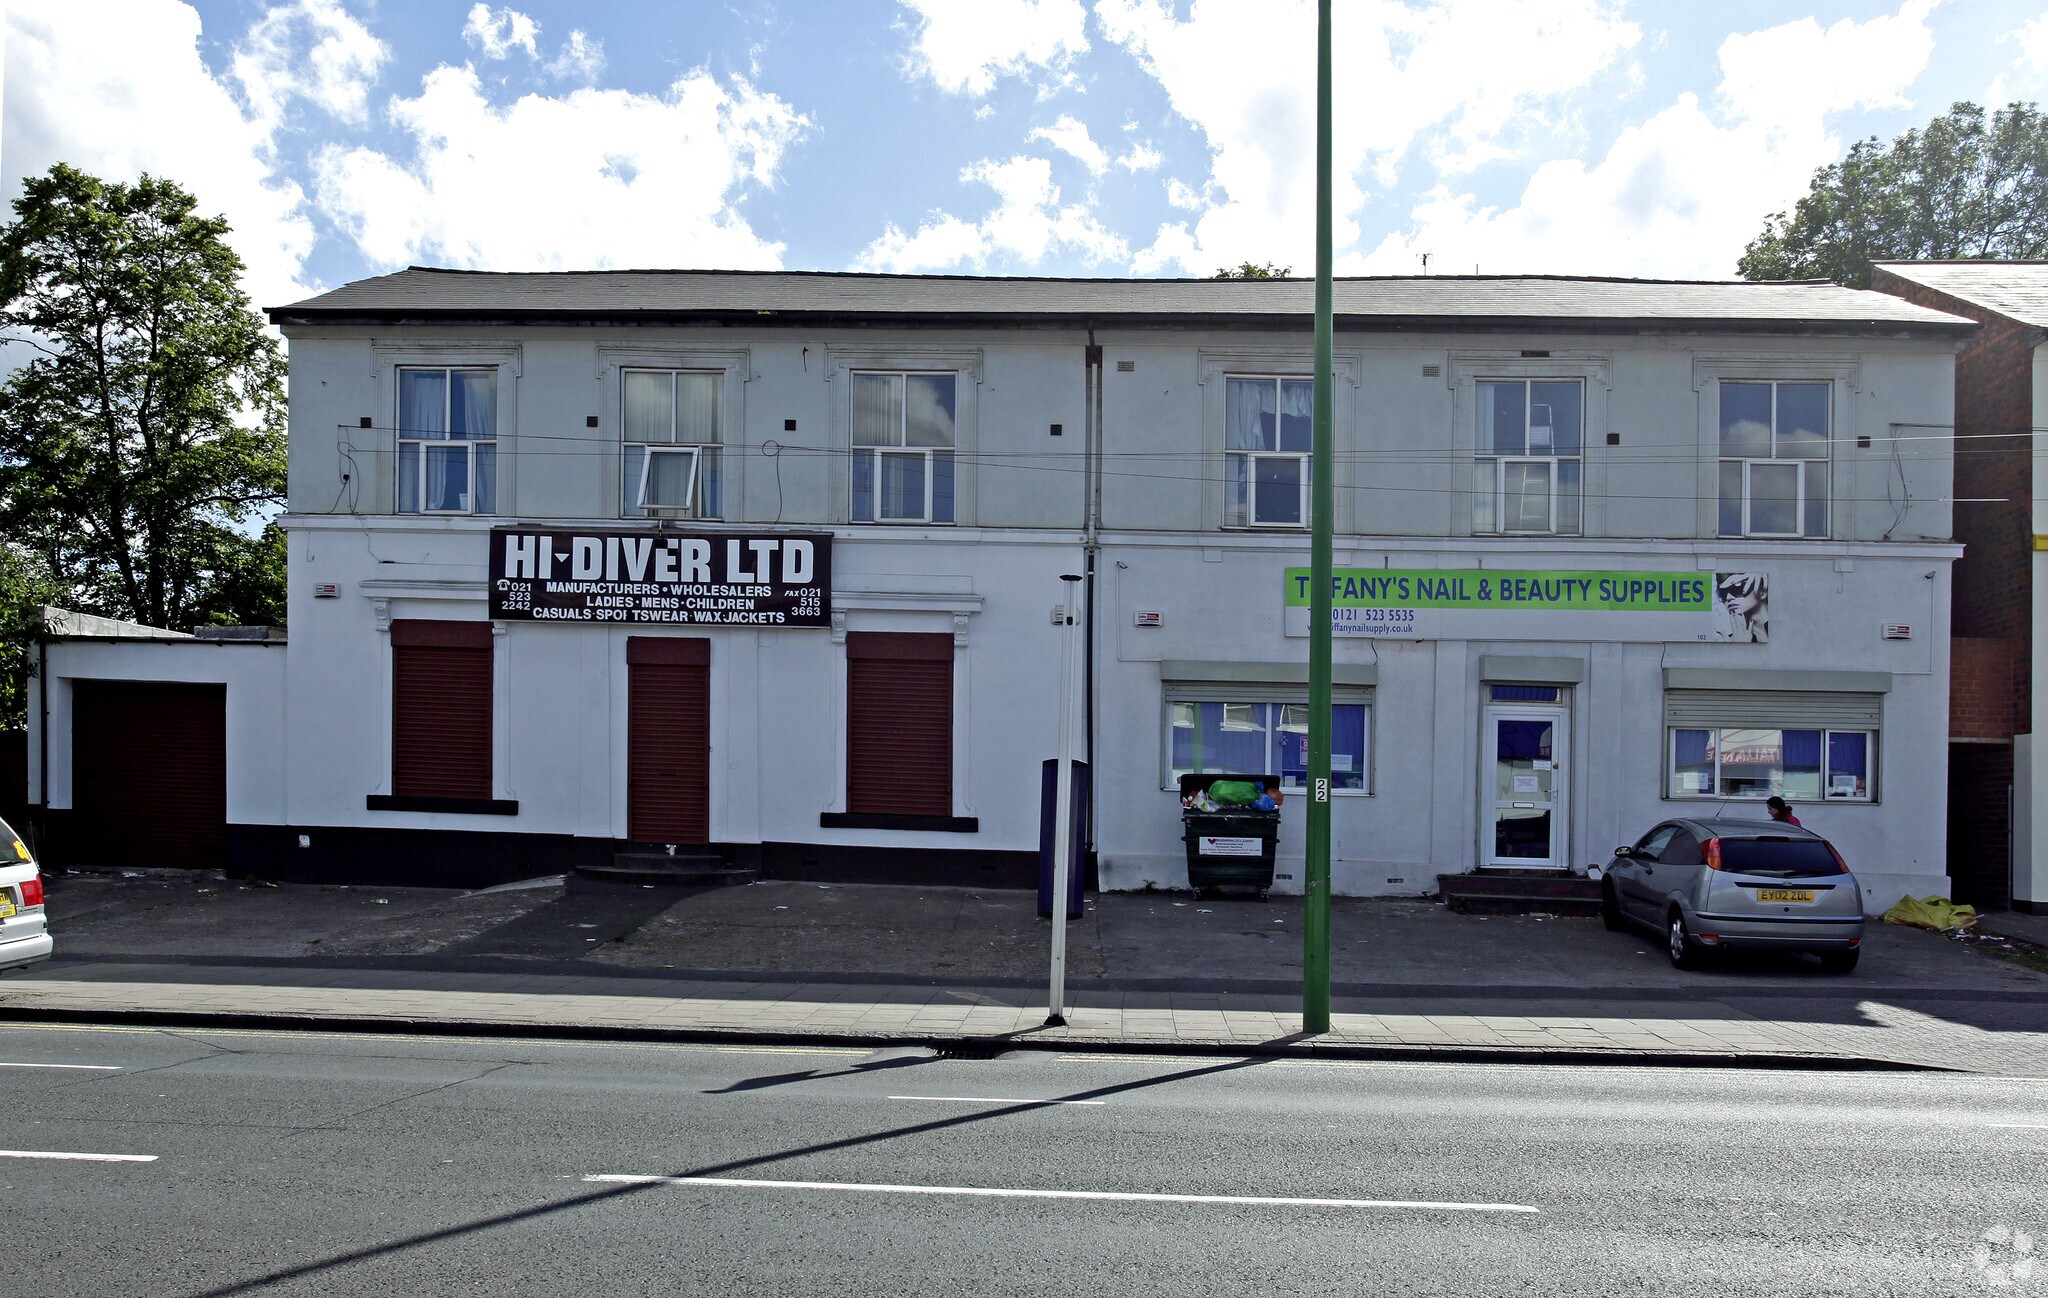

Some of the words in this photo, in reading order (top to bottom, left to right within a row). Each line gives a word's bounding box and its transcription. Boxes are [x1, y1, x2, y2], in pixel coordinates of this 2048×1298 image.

[727, 539, 814, 584] LTD
[511, 582, 532, 592] 021
[546, 582, 660, 595] MANUFACTURERS
[670, 584, 772, 597] WHOLESALERS
[800, 588, 821, 597] 021
[1295, 576, 1410, 600] TFANY'S
[1417, 578, 1471, 601] NAIL
[1477, 578, 1493, 601] &
[1500, 579, 1593, 602] BEAUTY
[1599, 579, 1705, 603] SUPPLIES
[509, 592, 531, 601] 523
[800, 598, 821, 607] 515
[501, 601, 531, 611] 2242
[586, 596, 634, 608] LADIES
[641, 597, 679, 609] MENS
[686, 598, 755, 610] CHILDREN
[533, 607, 592, 620] CASUALS
[693, 611, 722, 623] WAX
[724, 612, 785, 624] JACKETS
[791, 607, 821, 616] 3663
[1333, 608, 1357, 621] 0121
[1365, 609, 1385, 621] 523
[1389, 609, 1415, 622] 5535
